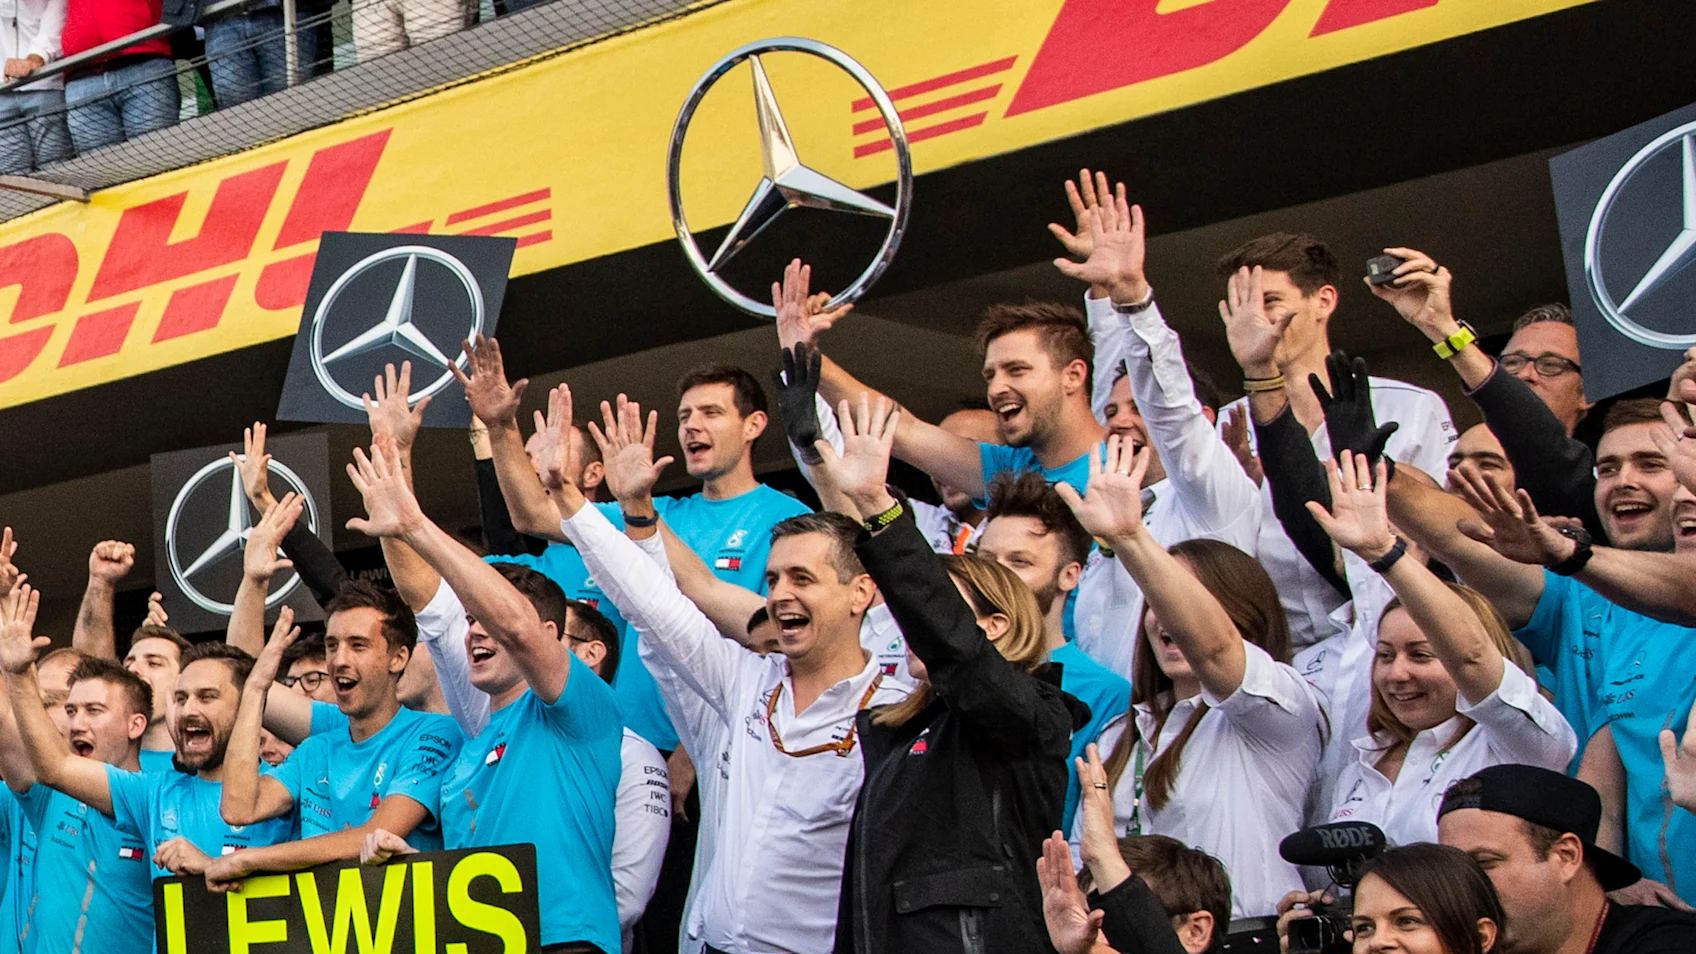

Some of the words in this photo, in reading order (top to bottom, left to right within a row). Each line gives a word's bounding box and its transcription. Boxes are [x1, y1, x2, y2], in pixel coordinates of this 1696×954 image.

[419, 733, 452, 750] EPSON
[650, 790, 666, 802] IWC
[1315, 826, 1375, 848] RØDE
